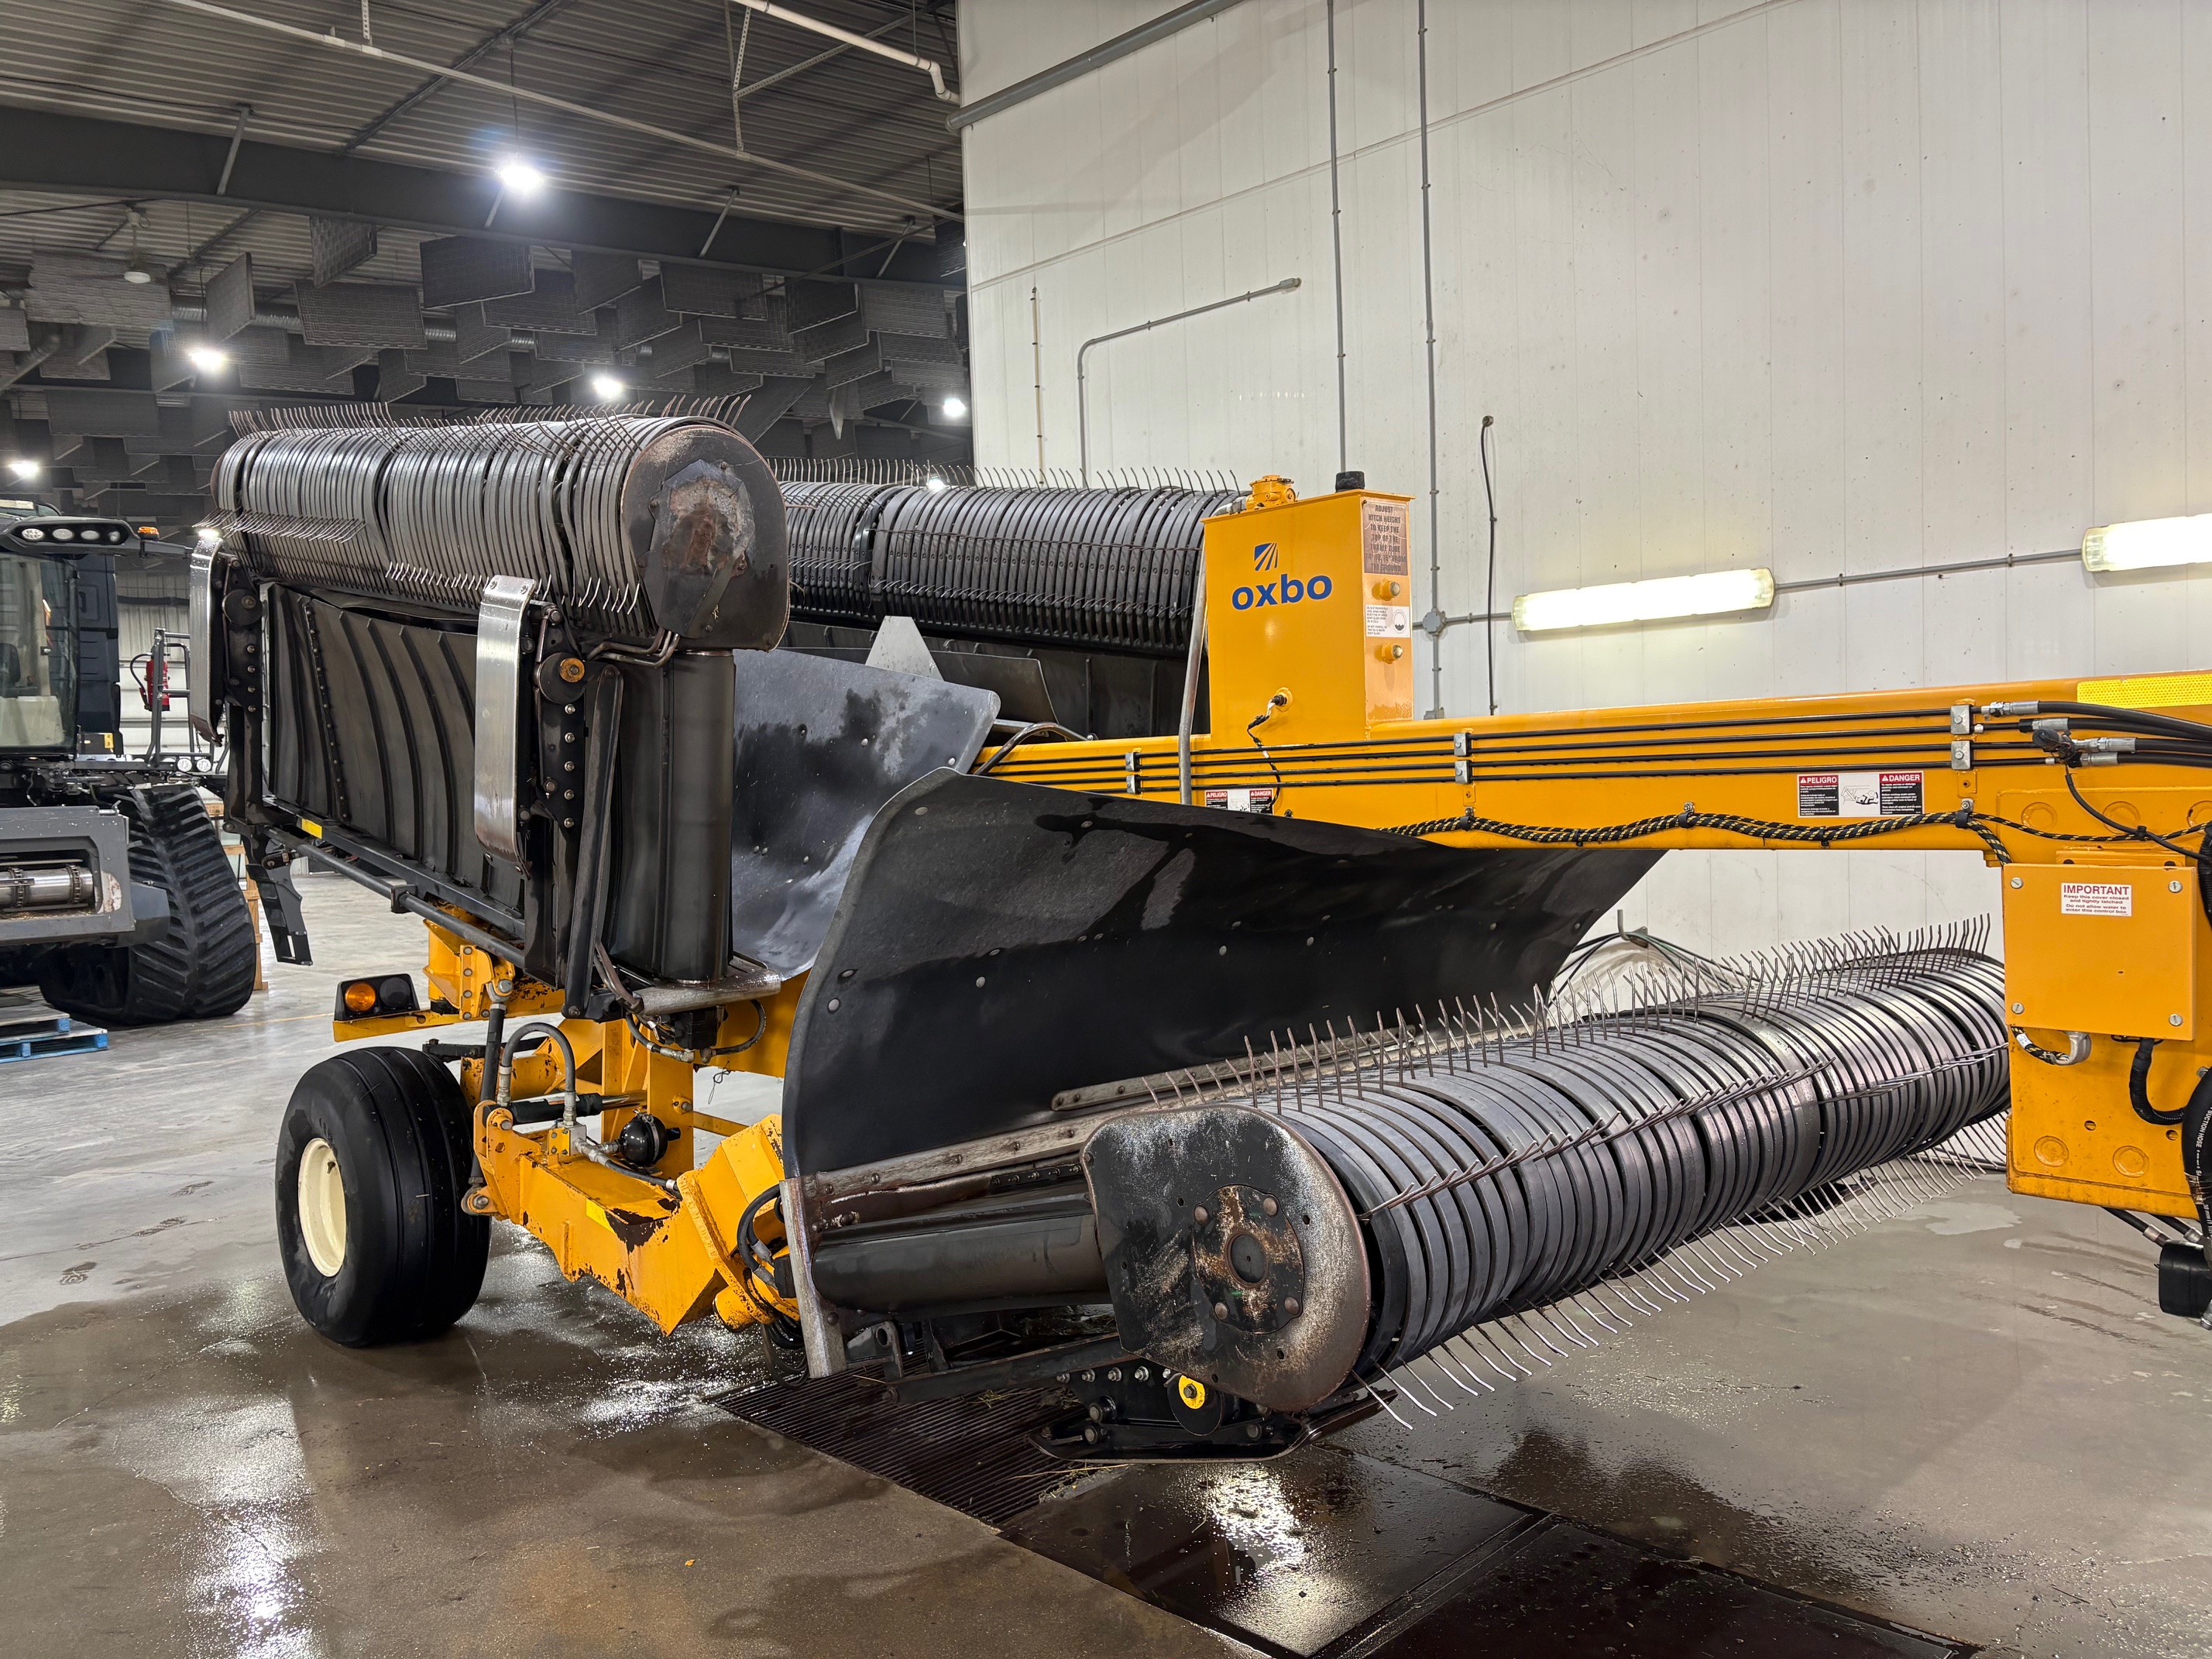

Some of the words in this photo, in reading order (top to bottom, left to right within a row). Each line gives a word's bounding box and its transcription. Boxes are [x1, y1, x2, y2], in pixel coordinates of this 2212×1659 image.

[1375, 505, 1393, 514] ADJUST
[1231, 574, 1333, 610] oxbo
[2063, 884, 2129, 895] IMPORTANT
[2200, 1110, 2212, 1133] SUCTION
[2196, 1132, 2205, 1148] HOSE
